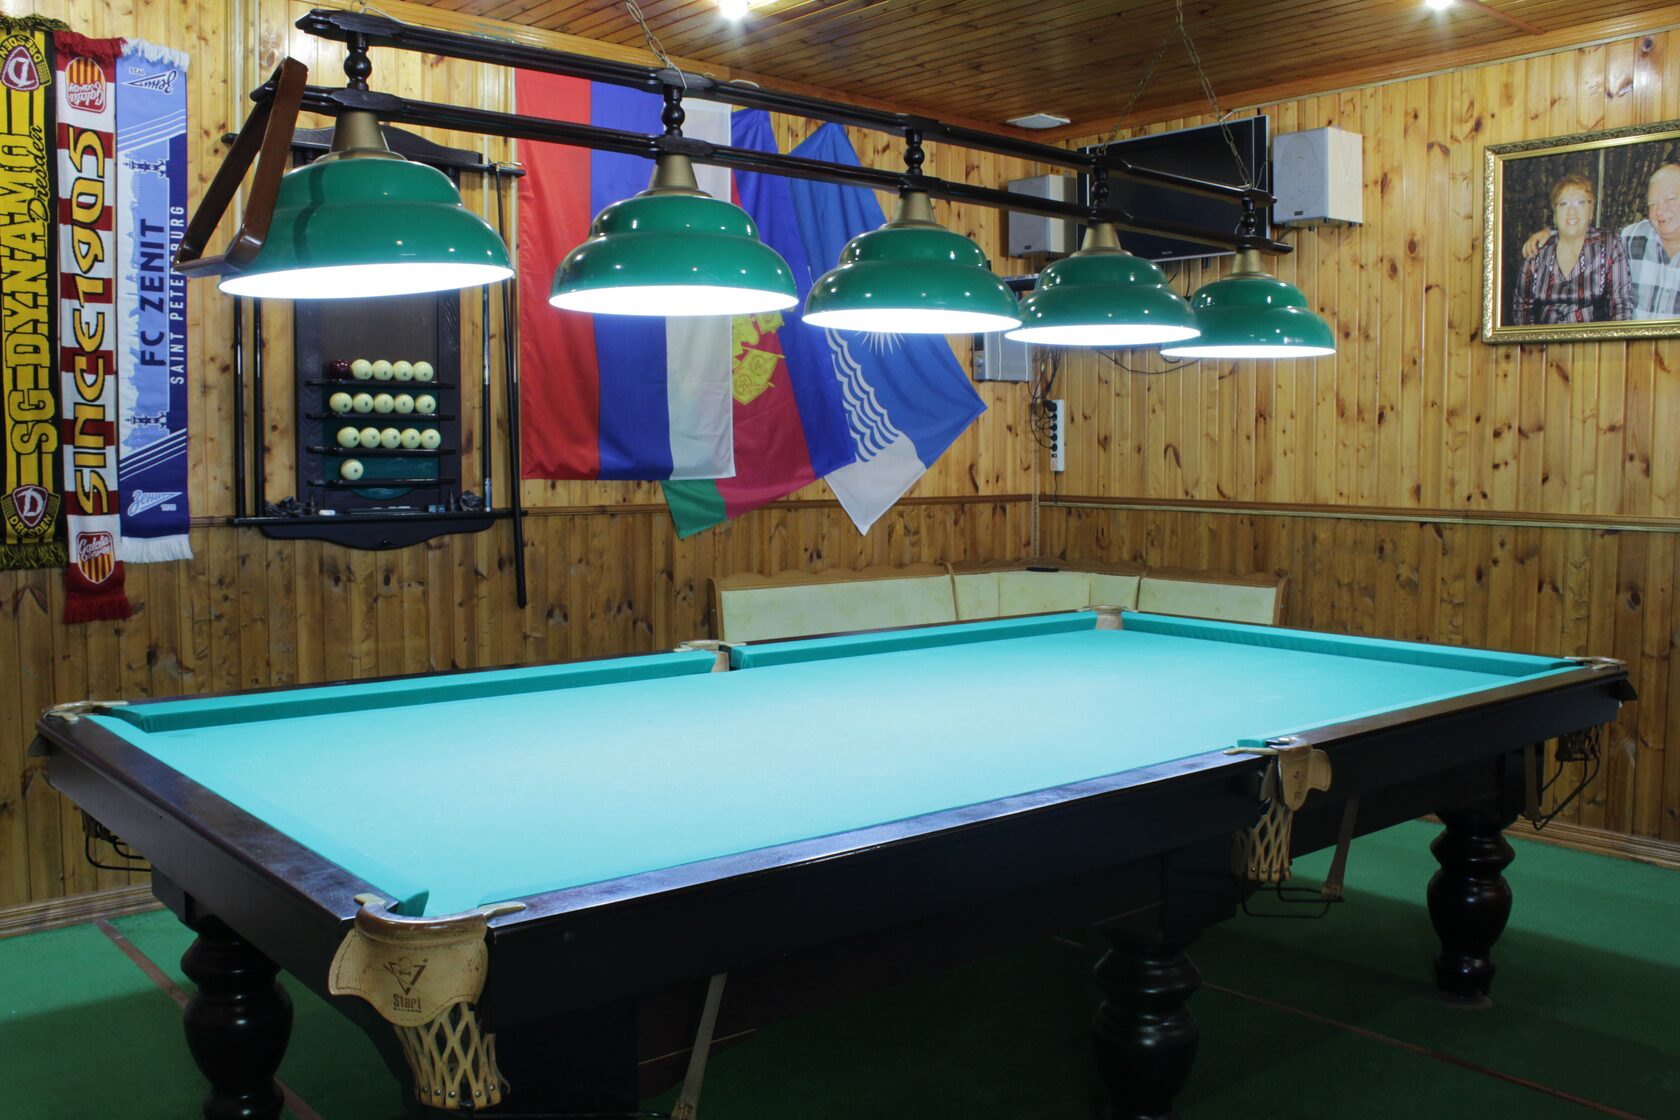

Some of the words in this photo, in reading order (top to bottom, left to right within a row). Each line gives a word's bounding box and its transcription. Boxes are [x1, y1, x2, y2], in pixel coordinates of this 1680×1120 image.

[0, 35, 43, 63] DRESDEN
[27, 125, 49, 222] Dresden
[0, 133, 50, 368] DYNAMO
[140, 218, 165, 314] ZENIT
[140, 331, 167, 366] FC
[170, 334, 185, 384] SAINT
[8, 389, 58, 454] SG
[10, 515, 53, 537] DRESDEN
